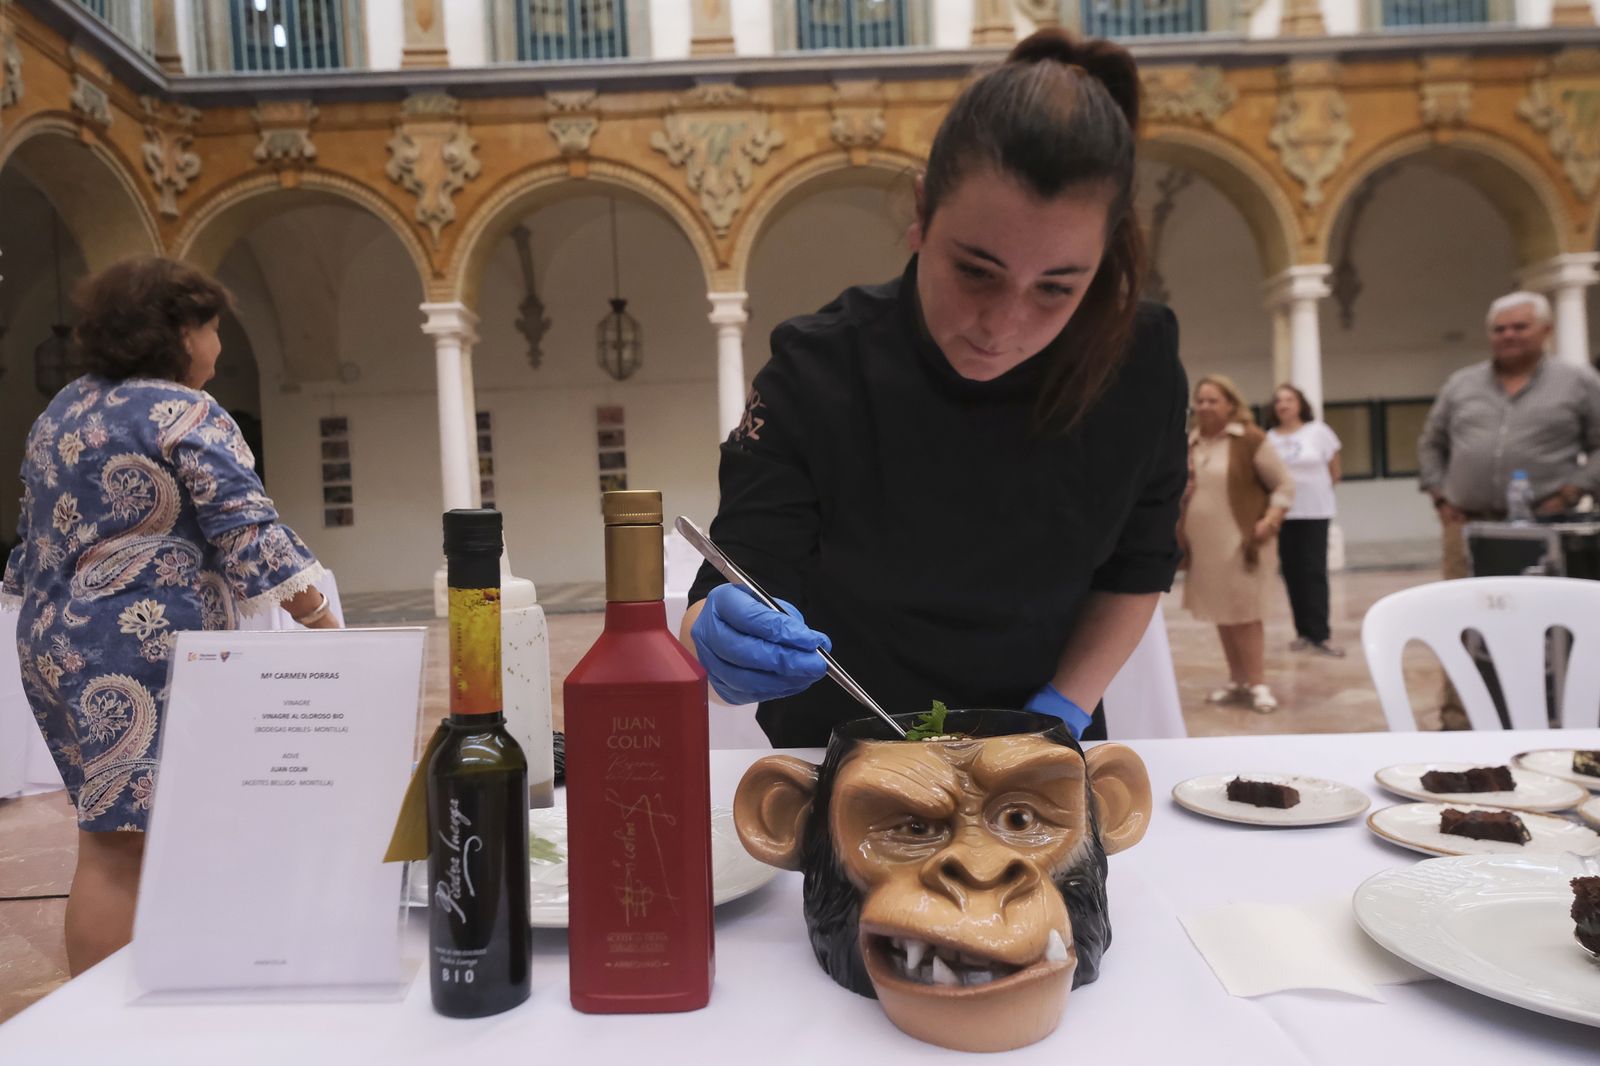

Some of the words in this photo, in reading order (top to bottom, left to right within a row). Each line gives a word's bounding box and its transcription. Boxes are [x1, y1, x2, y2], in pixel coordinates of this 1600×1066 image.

[275, 672, 307, 680] CARMEN
[310, 672, 339, 680] PORRAS
[612, 717, 656, 738] JUAN
[607, 735, 661, 753] COLIN
[442, 967, 475, 984] BIO
